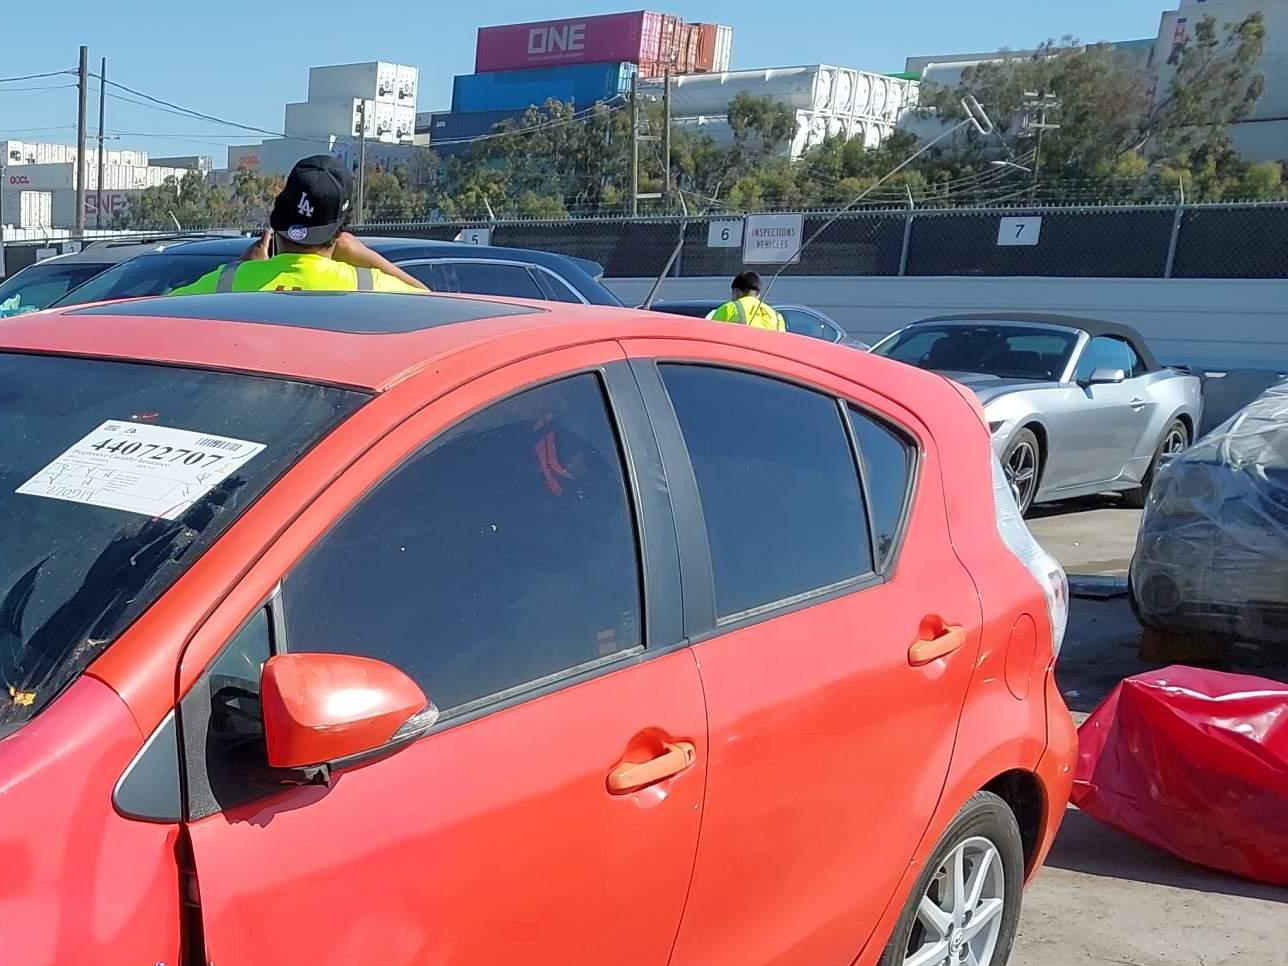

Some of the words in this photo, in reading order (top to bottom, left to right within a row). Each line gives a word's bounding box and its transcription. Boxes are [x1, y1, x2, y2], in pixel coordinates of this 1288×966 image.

[527, 24, 587, 54] ONE
[297, 191, 314, 217] LA
[721, 227, 730, 241] 6
[752, 227, 796, 237] INSPECTIONS
[1015, 223, 1026, 239] 7
[756, 239, 789, 249] VEHICLES
[91, 437, 225, 468] 44072707
